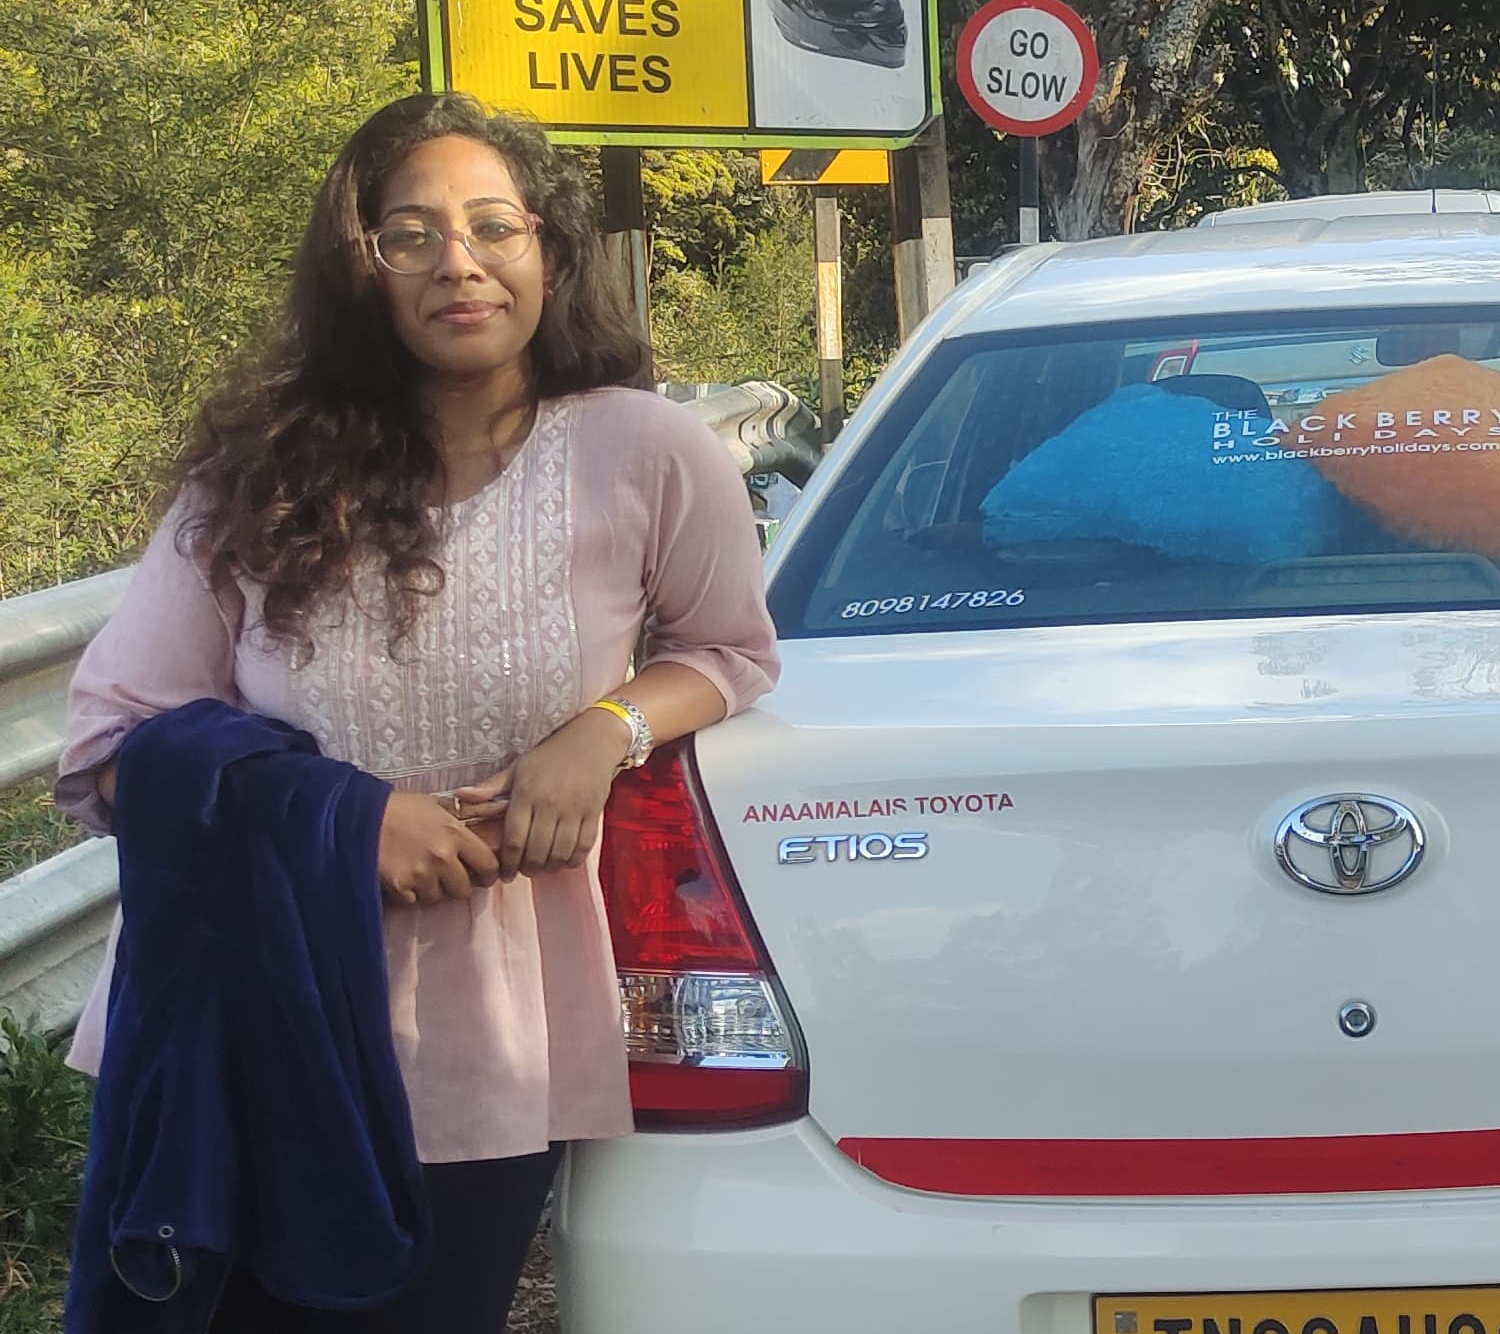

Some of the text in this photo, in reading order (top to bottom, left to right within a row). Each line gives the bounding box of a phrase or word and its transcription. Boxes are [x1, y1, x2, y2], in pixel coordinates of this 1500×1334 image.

[1009, 29, 1049, 59] GO
[528, 51, 672, 94] LIVES
[987, 68, 1067, 103] SLOW
[1212, 410, 1258, 421] THE
[1213, 414, 1356, 438] BLACK
[1212, 441, 1500, 465] www.blackberryholidays.com
[841, 589, 1025, 619] 8098147826
[742, 793, 1014, 823] ANAAMALAIS TOYOTA
[778, 832, 929, 865] ETIOS
